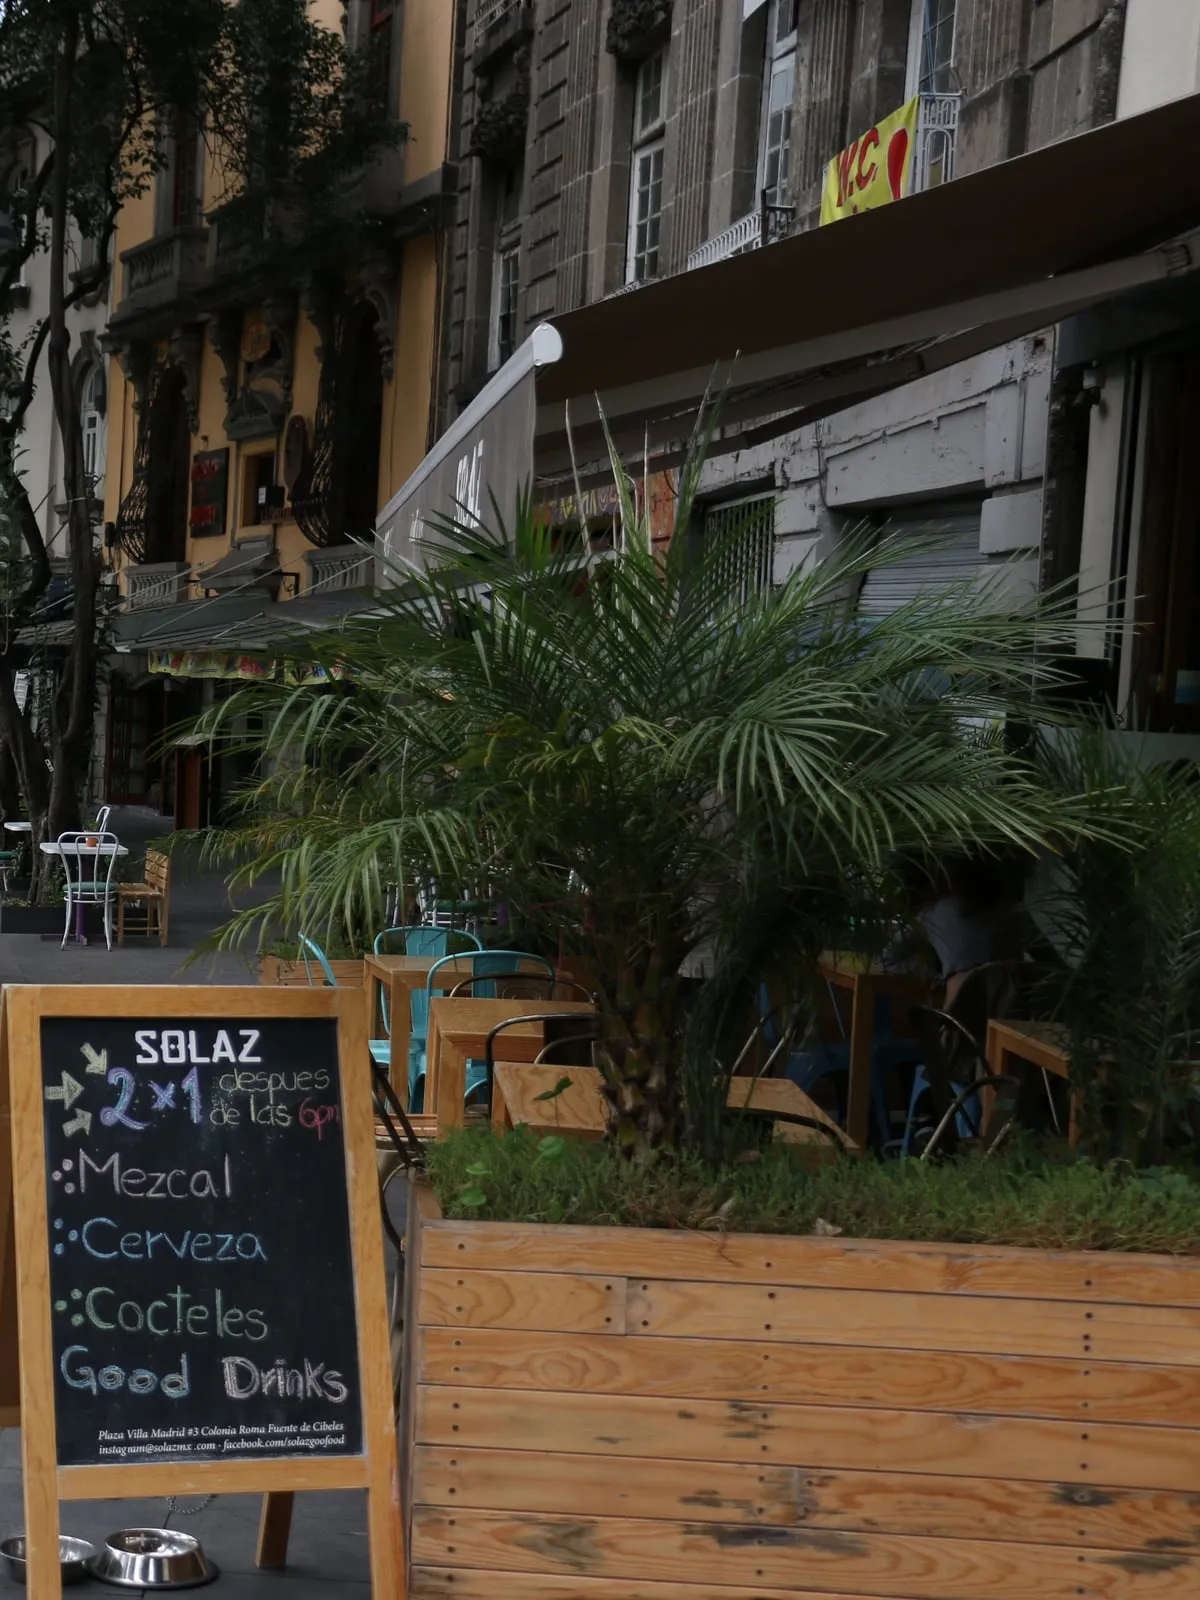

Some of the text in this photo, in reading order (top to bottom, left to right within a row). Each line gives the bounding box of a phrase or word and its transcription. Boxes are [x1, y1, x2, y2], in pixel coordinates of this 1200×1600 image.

[135, 1030, 262, 1063] SOLAZ
[218, 1067, 331, 1104] despues
[209, 1103, 241, 1125] de
[250, 1094, 293, 1127] las
[79, 1148, 232, 1198] Mezcal
[82, 1217, 268, 1261] Cerveza
[85, 1285, 269, 1340] Cocteles
[60, 1344, 348, 1403] Good Drinks
[98, 1420, 344, 1440] Plaza Villa Madrid #3 Colonia Roma Fuente de Cibeles
[99, 1442, 192, 1456] instagram@solazmx
[222, 1434, 345, 1452] facebook.com/solazgoofood
